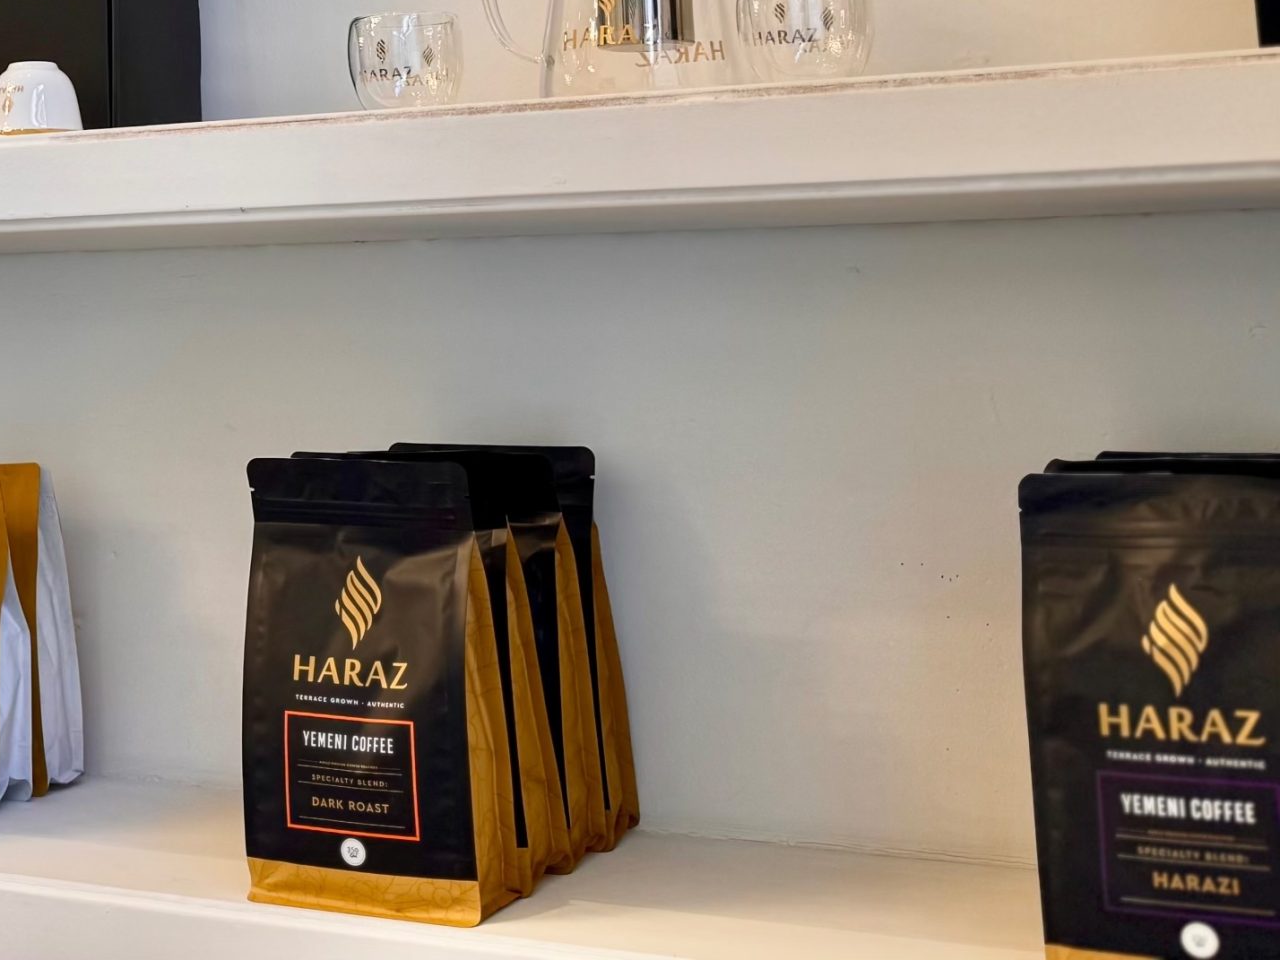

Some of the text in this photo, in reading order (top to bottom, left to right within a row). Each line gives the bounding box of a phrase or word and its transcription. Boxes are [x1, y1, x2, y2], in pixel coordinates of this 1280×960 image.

[563, 23, 657, 51] HARAZ
[752, 27, 821, 47] HARAZ
[293, 654, 408, 690] HARAZ
[295, 694, 405, 709] TERRACE GROWN AUTHENTIC
[1098, 701, 1267, 747] HARAZ
[302, 729, 394, 755] YEMENI COFFEE
[1106, 749, 1266, 770] TERRACE GROWN AUTHENTIC
[311, 773, 388, 788] SPECIALTY BLEND:
[311, 796, 389, 814] DARK ROAST
[1120, 792, 1257, 824] YEMENI COFFEE
[1136, 845, 1201, 859] SPECIALTY
[1151, 870, 1241, 897] HARAZI
